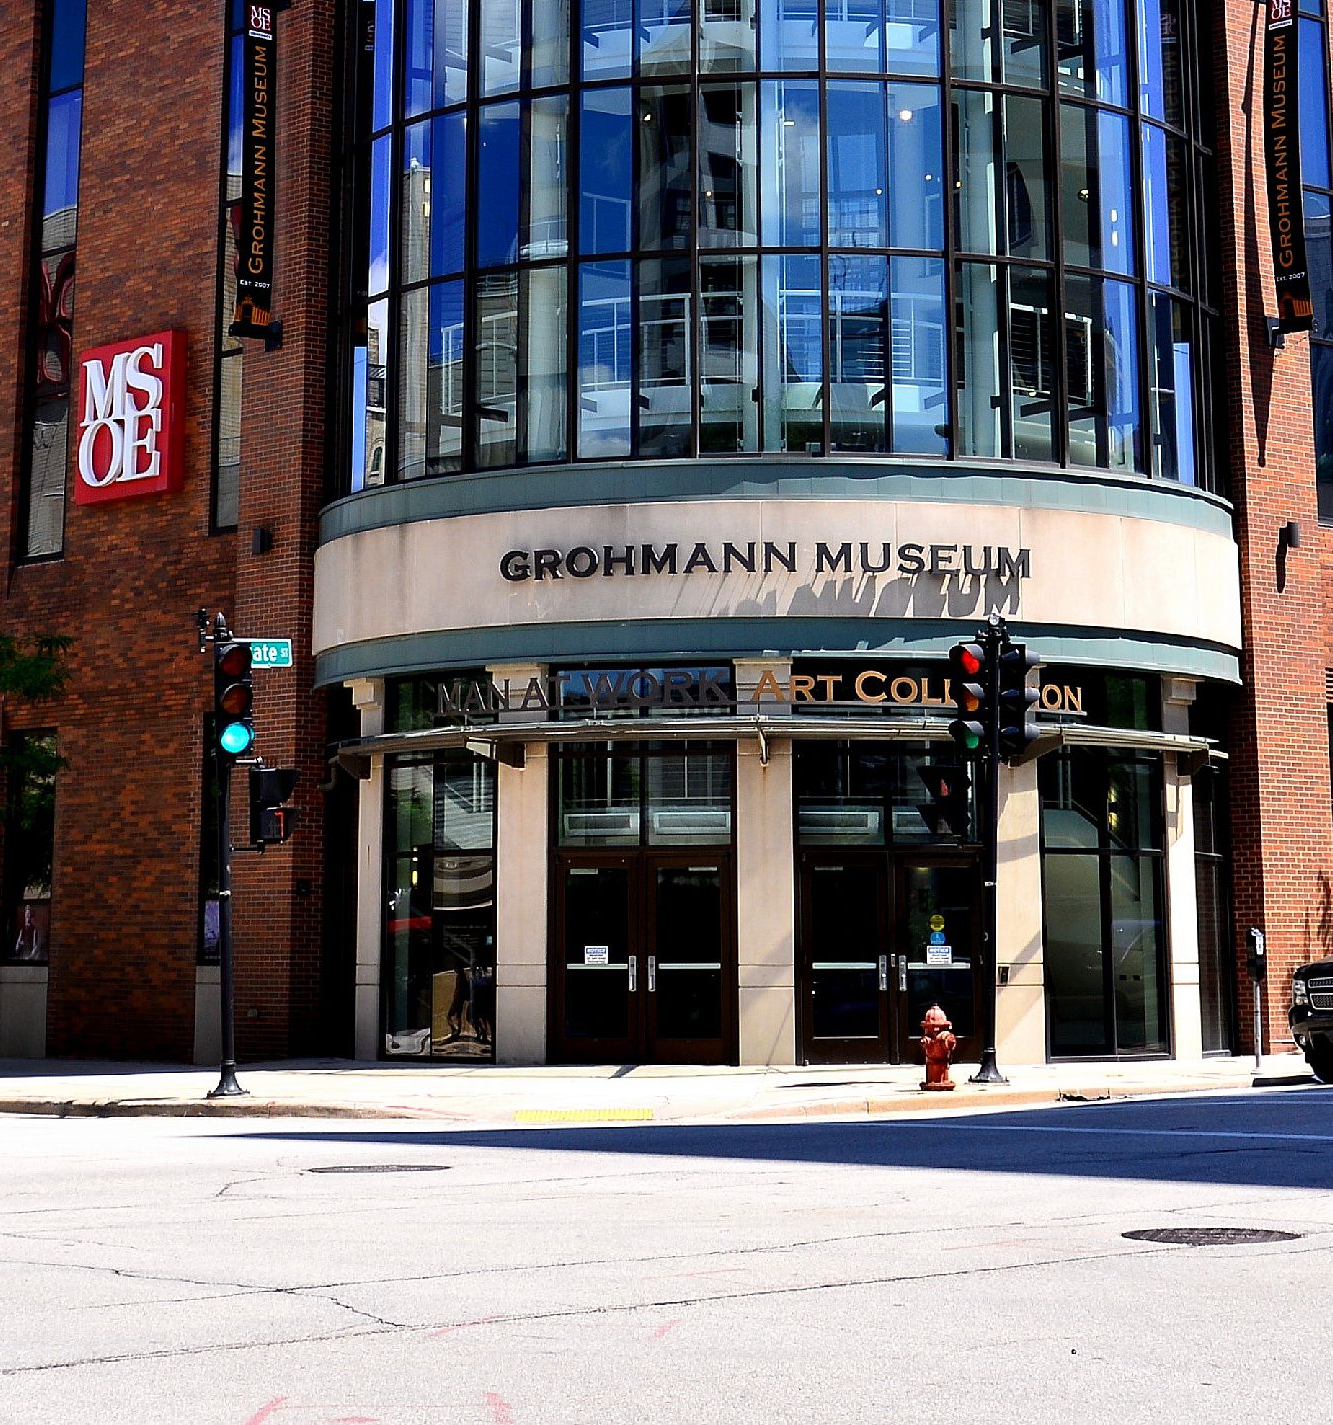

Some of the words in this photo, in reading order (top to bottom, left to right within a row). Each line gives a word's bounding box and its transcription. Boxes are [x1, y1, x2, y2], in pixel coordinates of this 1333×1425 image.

[251, 46, 267, 139] MUSEUM
[1271, 35, 1286, 129] MUSEUM
[248, 145, 267, 274] GROHMANN
[499, 541, 797, 582] GROHMANN
[814, 541, 1032, 579] MUSEUM
[437, 677, 512, 715] MAN
[521, 672, 571, 710] AT
[581, 669, 732, 707] WORK
[750, 669, 843, 704] ART
